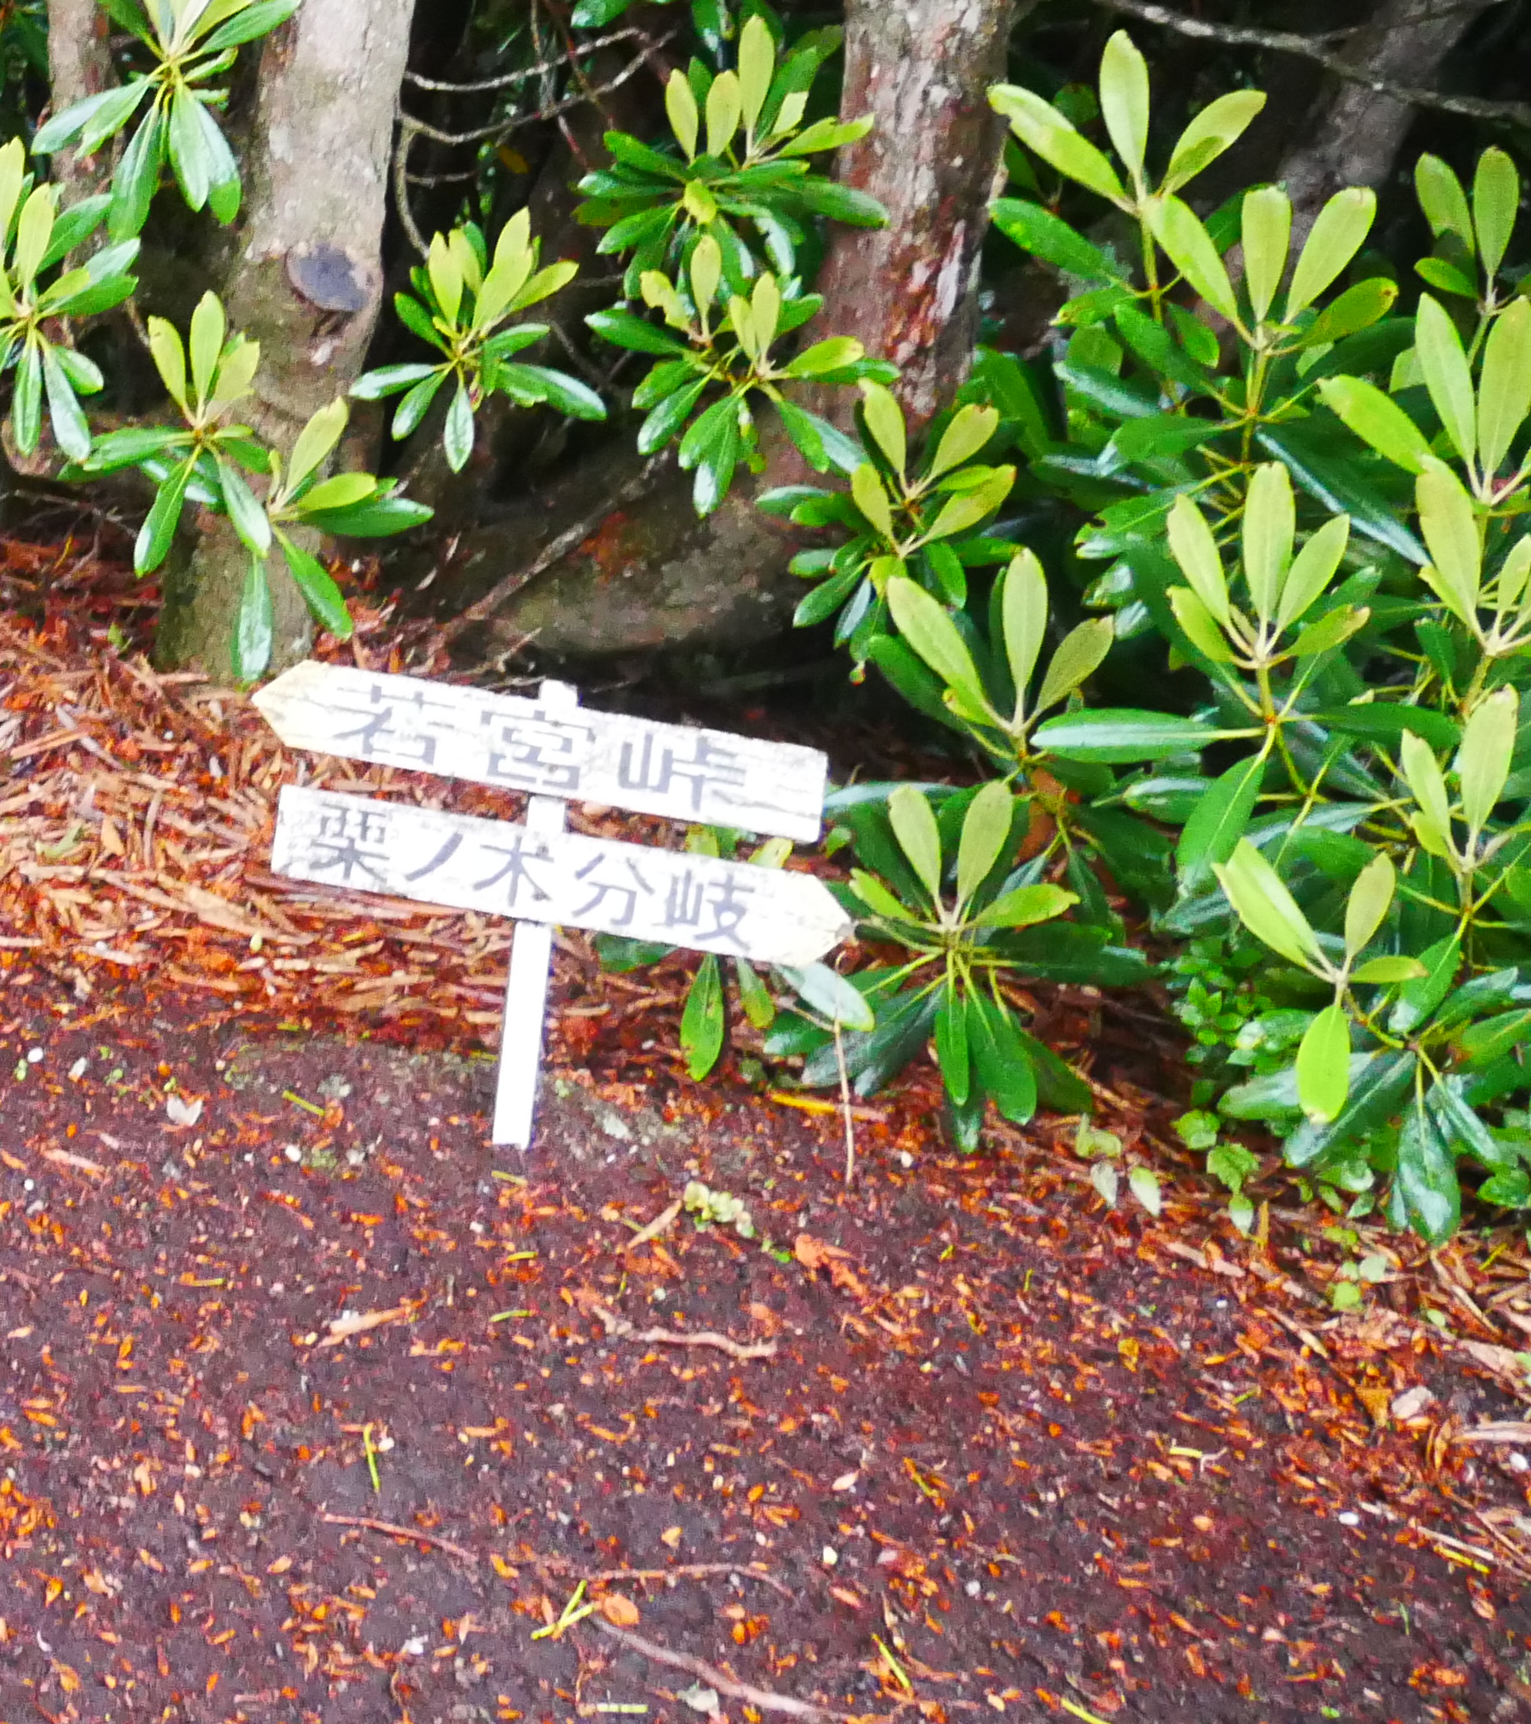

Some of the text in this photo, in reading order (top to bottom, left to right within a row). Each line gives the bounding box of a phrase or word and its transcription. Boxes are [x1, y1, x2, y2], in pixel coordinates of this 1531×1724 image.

[335, 686, 748, 813] 若宮峠
[309, 803, 757, 951] 栗ノ木分岐
